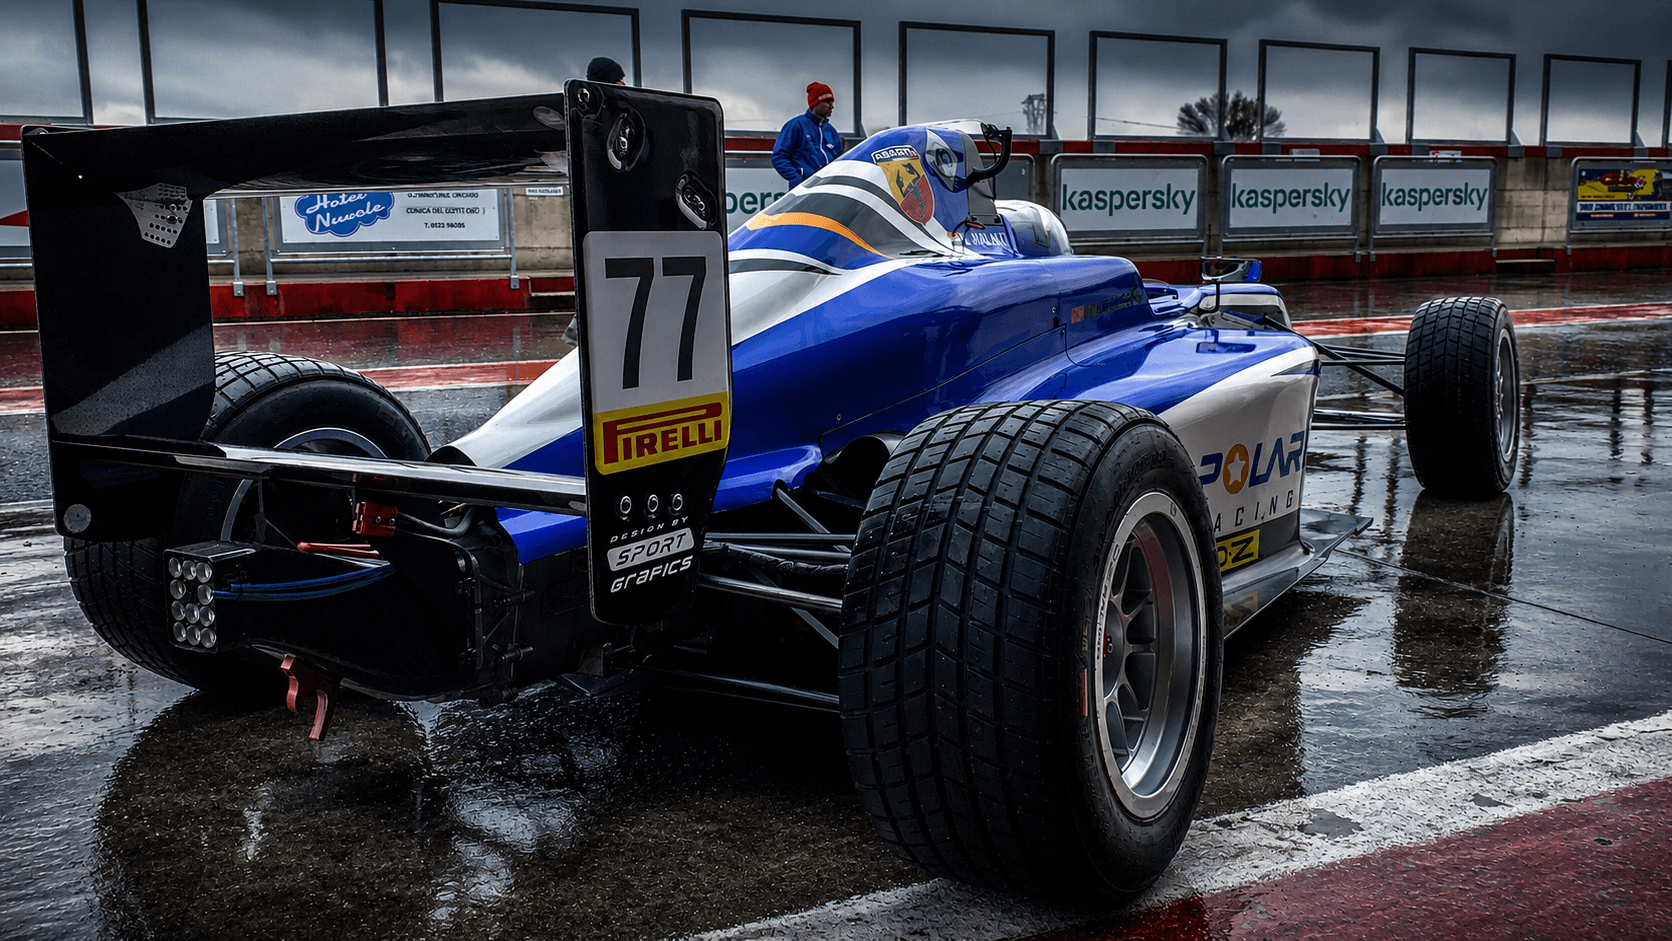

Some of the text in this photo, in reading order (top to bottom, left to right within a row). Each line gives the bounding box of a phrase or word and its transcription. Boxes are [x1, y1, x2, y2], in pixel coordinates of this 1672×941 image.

[1062, 183, 1196, 217] kaspersky
[1232, 182, 1350, 214] kaspersky
[1381, 182, 1488, 212] kaspersky
[604, 256, 706, 389] 77
[602, 402, 722, 464] PIRELLI
[1213, 489, 1294, 533] ACING
[615, 532, 687, 567] SPORT
